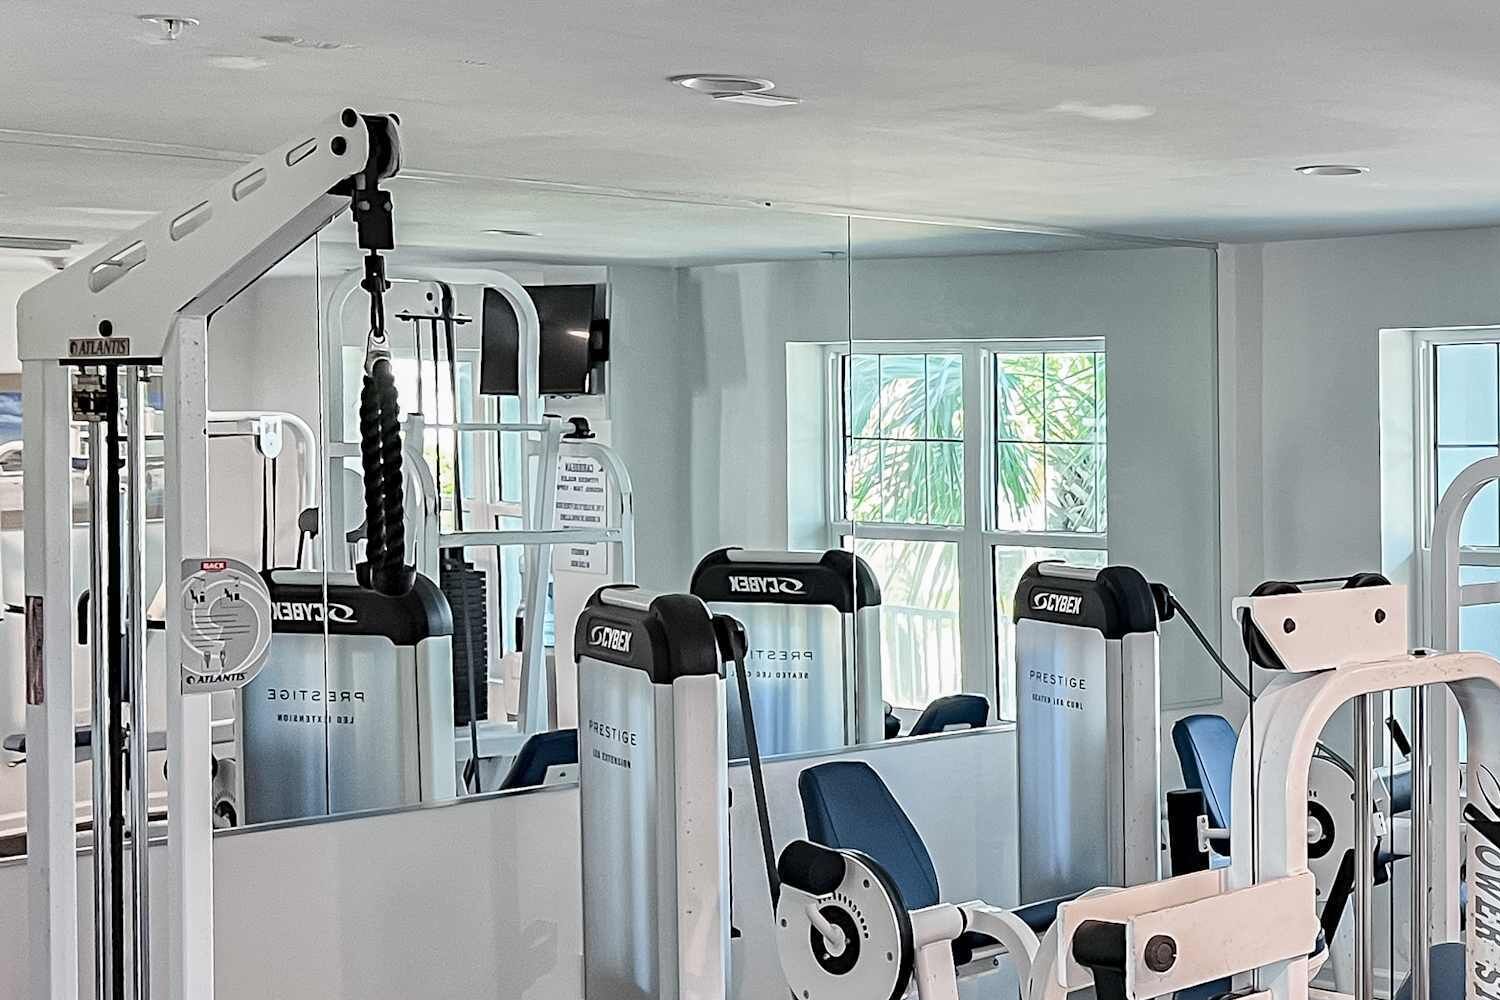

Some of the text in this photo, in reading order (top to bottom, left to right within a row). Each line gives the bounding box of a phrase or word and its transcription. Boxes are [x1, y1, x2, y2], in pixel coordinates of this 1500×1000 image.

[80, 340, 126, 354] ATLANTIS
[1047, 593, 1082, 615] CYBEX
[602, 627, 632, 652] CYBEX
[197, 673, 247, 684] ATLANTIS
[1030, 670, 1087, 690] PRESTIGE
[589, 719, 638, 746] PRESTIGE
